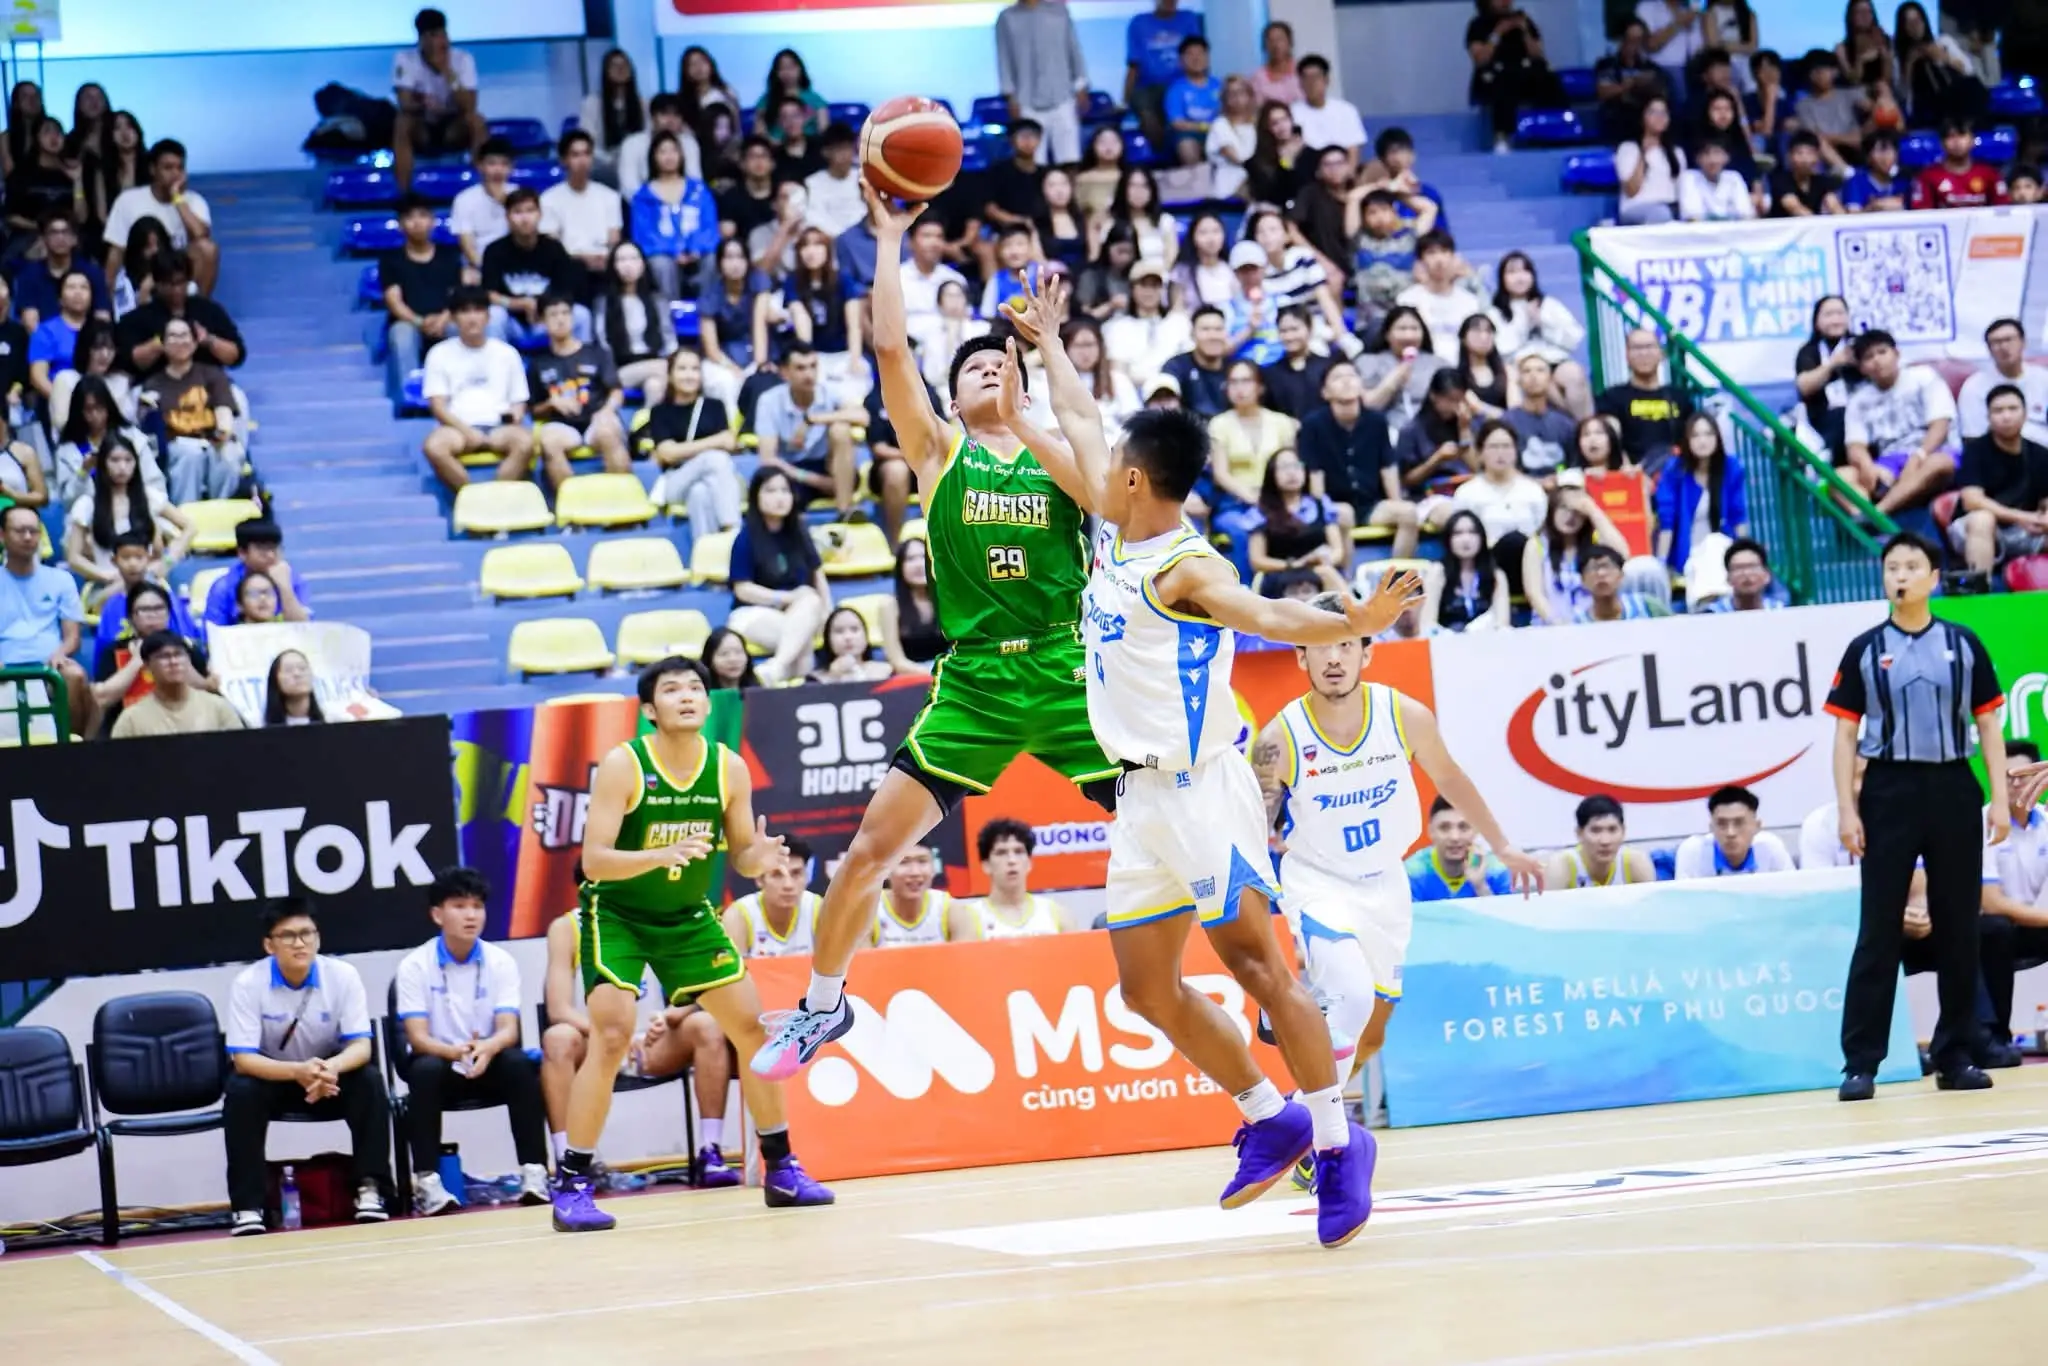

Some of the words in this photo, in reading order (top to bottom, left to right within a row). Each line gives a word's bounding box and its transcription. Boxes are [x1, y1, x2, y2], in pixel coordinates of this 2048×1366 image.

[1641, 262, 1701, 282] MUA
[1748, 248, 1822, 278] TÊN
[1750, 276, 1823, 309] MINI
[962, 488, 1050, 529] CATFISH
[986, 545, 1029, 581] 29
[801, 762, 889, 797] HOOPS
[1342, 818, 1381, 852] 00
[83, 800, 436, 911] TikTok
[1485, 983, 1544, 1008] THE
[1681, 961, 1793, 992] VILLAS
[1443, 1012, 1564, 1043] FOREST
[1585, 1003, 1643, 1031] BAY
[1022, 1084, 1096, 1110] cùng
[1104, 1077, 1177, 1103] vươn
